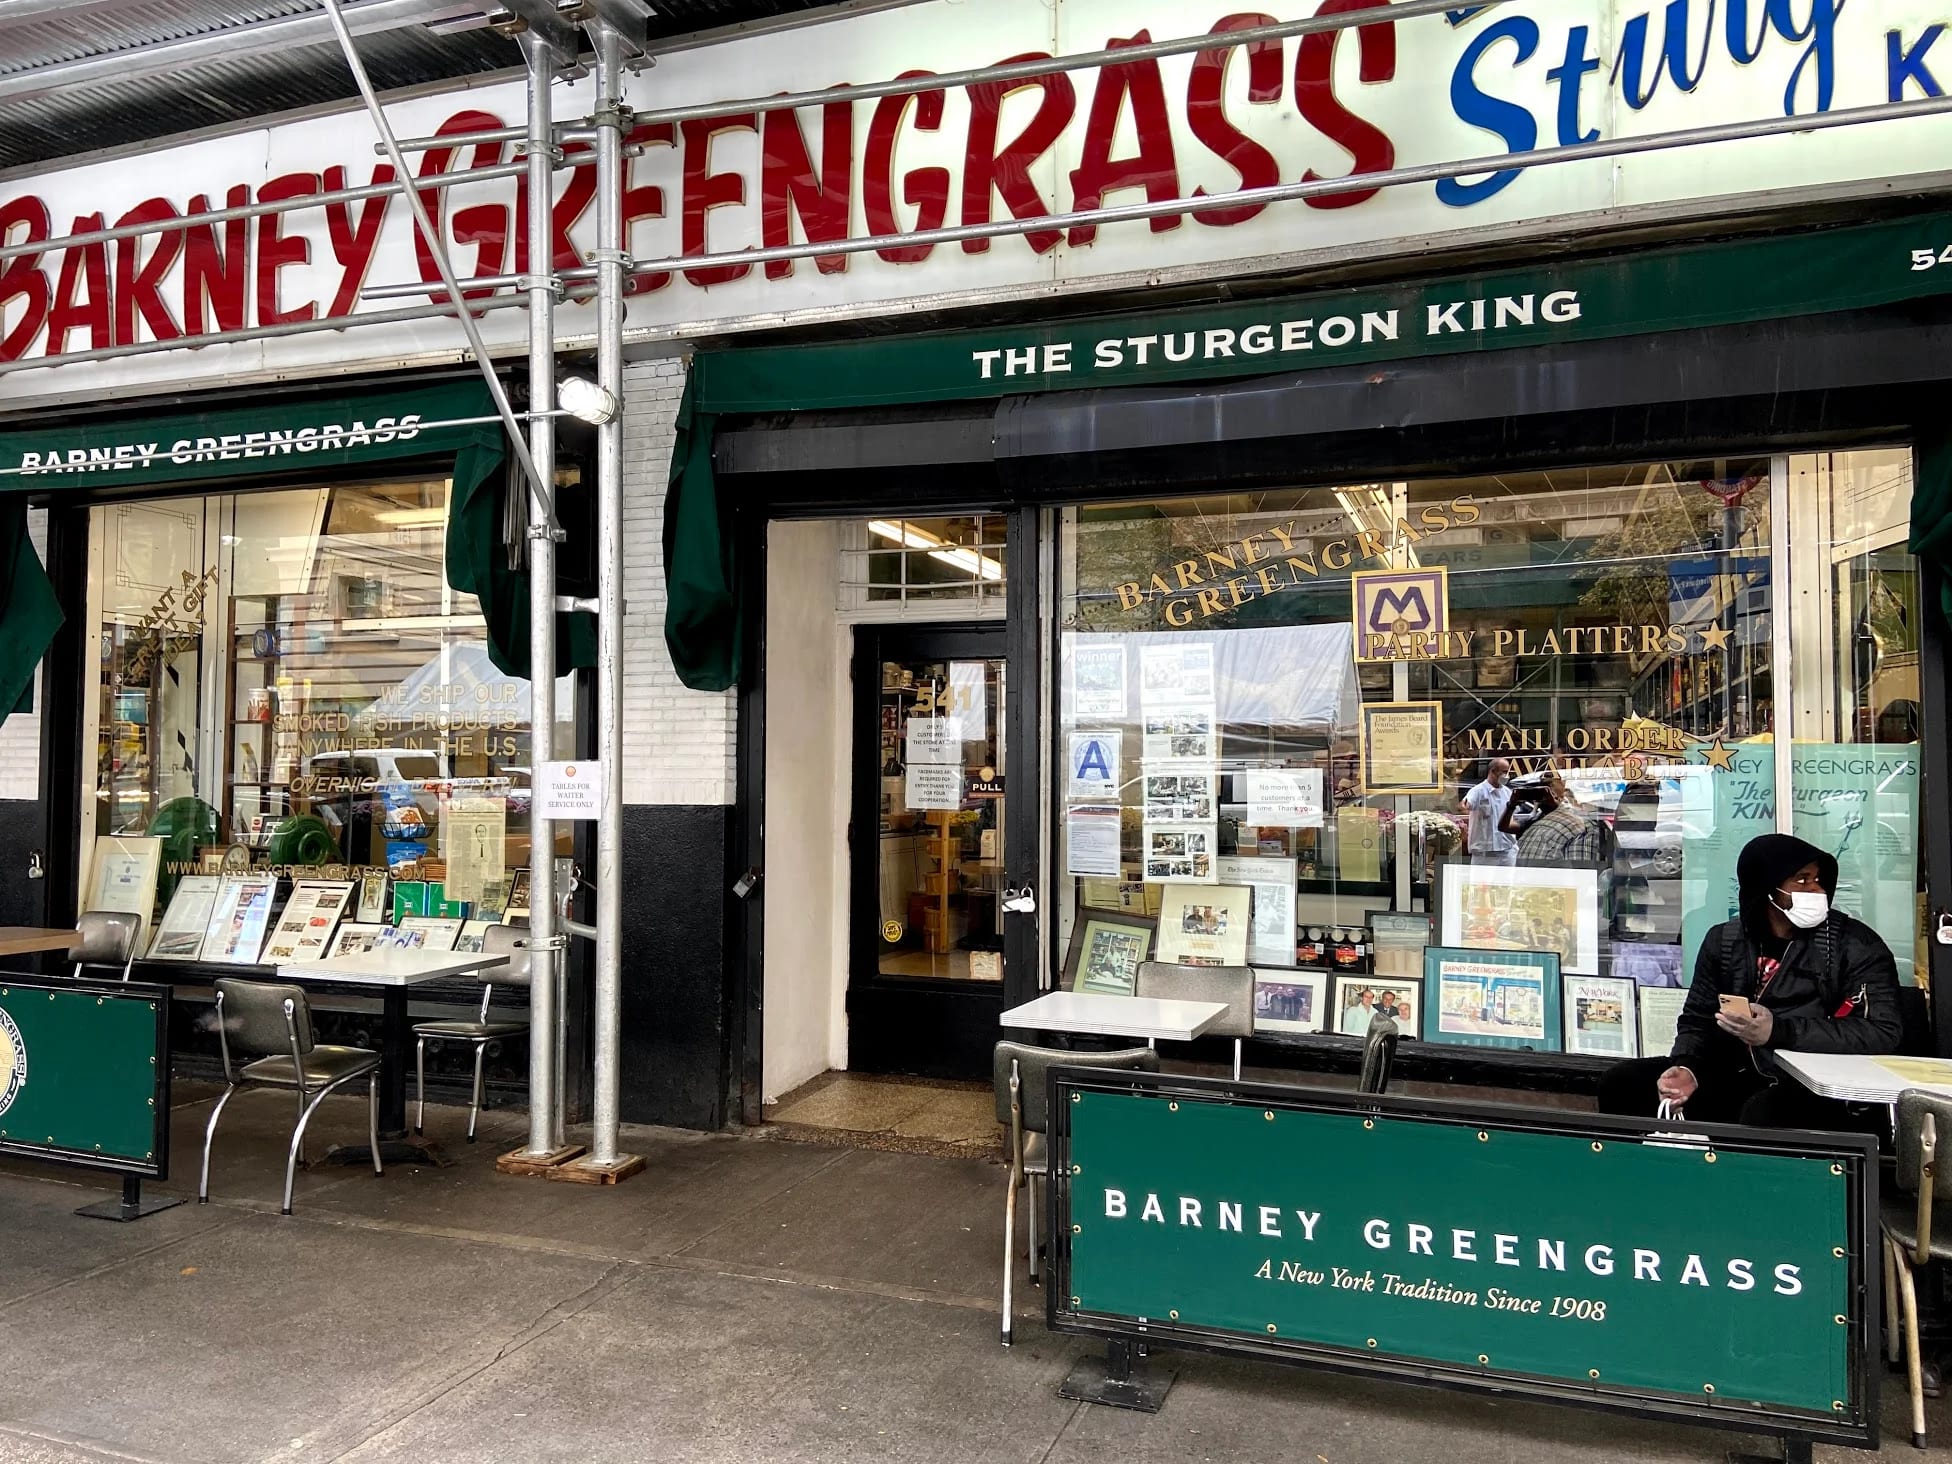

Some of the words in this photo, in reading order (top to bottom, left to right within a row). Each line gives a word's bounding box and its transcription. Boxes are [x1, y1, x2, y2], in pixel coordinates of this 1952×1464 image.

[0, 163, 395, 362] BARNEY
[413, 0, 1396, 319] GREENGRASS
[973, 342, 1072, 379] THE
[1094, 308, 1399, 369] STURGEON
[1426, 290, 1583, 336] KING
[20, 442, 158, 475] BARNEY
[172, 414, 422, 464] GREENGRASS
[1113, 520, 1298, 612] BARNEY
[1164, 493, 1481, 627] GREENGRASS
[183, 564, 220, 612] GIFT
[129, 586, 176, 641] WANT
[181, 569, 198, 589] A
[1077, 650, 1121, 663] winner
[1365, 629, 1476, 661] PARTY
[1493, 622, 1689, 658] PLATTERS
[380, 685, 409, 705] WE
[419, 684, 465, 704] SHIP
[473, 684, 518, 704] OUR
[911, 685, 973, 716] 541
[272, 712, 350, 733] SMOKED
[359, 711, 402, 732] FISH
[412, 710, 518, 732] PRODUCTS
[1375, 715, 1388, 723] The
[1388, 715, 1407, 723] James
[1409, 714, 1428, 722] Beard
[280, 736, 395, 757] ANYWHERE
[403, 736, 424, 755] IN
[432, 736, 474, 757] THE
[483, 736, 521, 757] U.S.
[1468, 728, 1553, 751] MAIL
[1566, 724, 1688, 751] ORDER
[1076, 740, 1111, 780] A
[1506, 755, 1688, 781] AVAILABLE
[1792, 759, 1917, 775] REENGRASS
[973, 783, 1002, 791] PULL
[1790, 784, 1869, 808] turgeon
[1467, 965, 1506, 975] GREENGRASS
[1103, 1187, 1324, 1241] BARNEY
[1363, 1217, 1804, 1298] GREENGRASS
[1254, 1259, 1273, 1281] A
[1279, 1260, 1326, 1288] New
[1327, 1263, 1376, 1296] York
[1380, 1273, 1479, 1308] Tradition
[1484, 1285, 1542, 1316] Since
[1548, 1294, 1608, 1324] 1908
